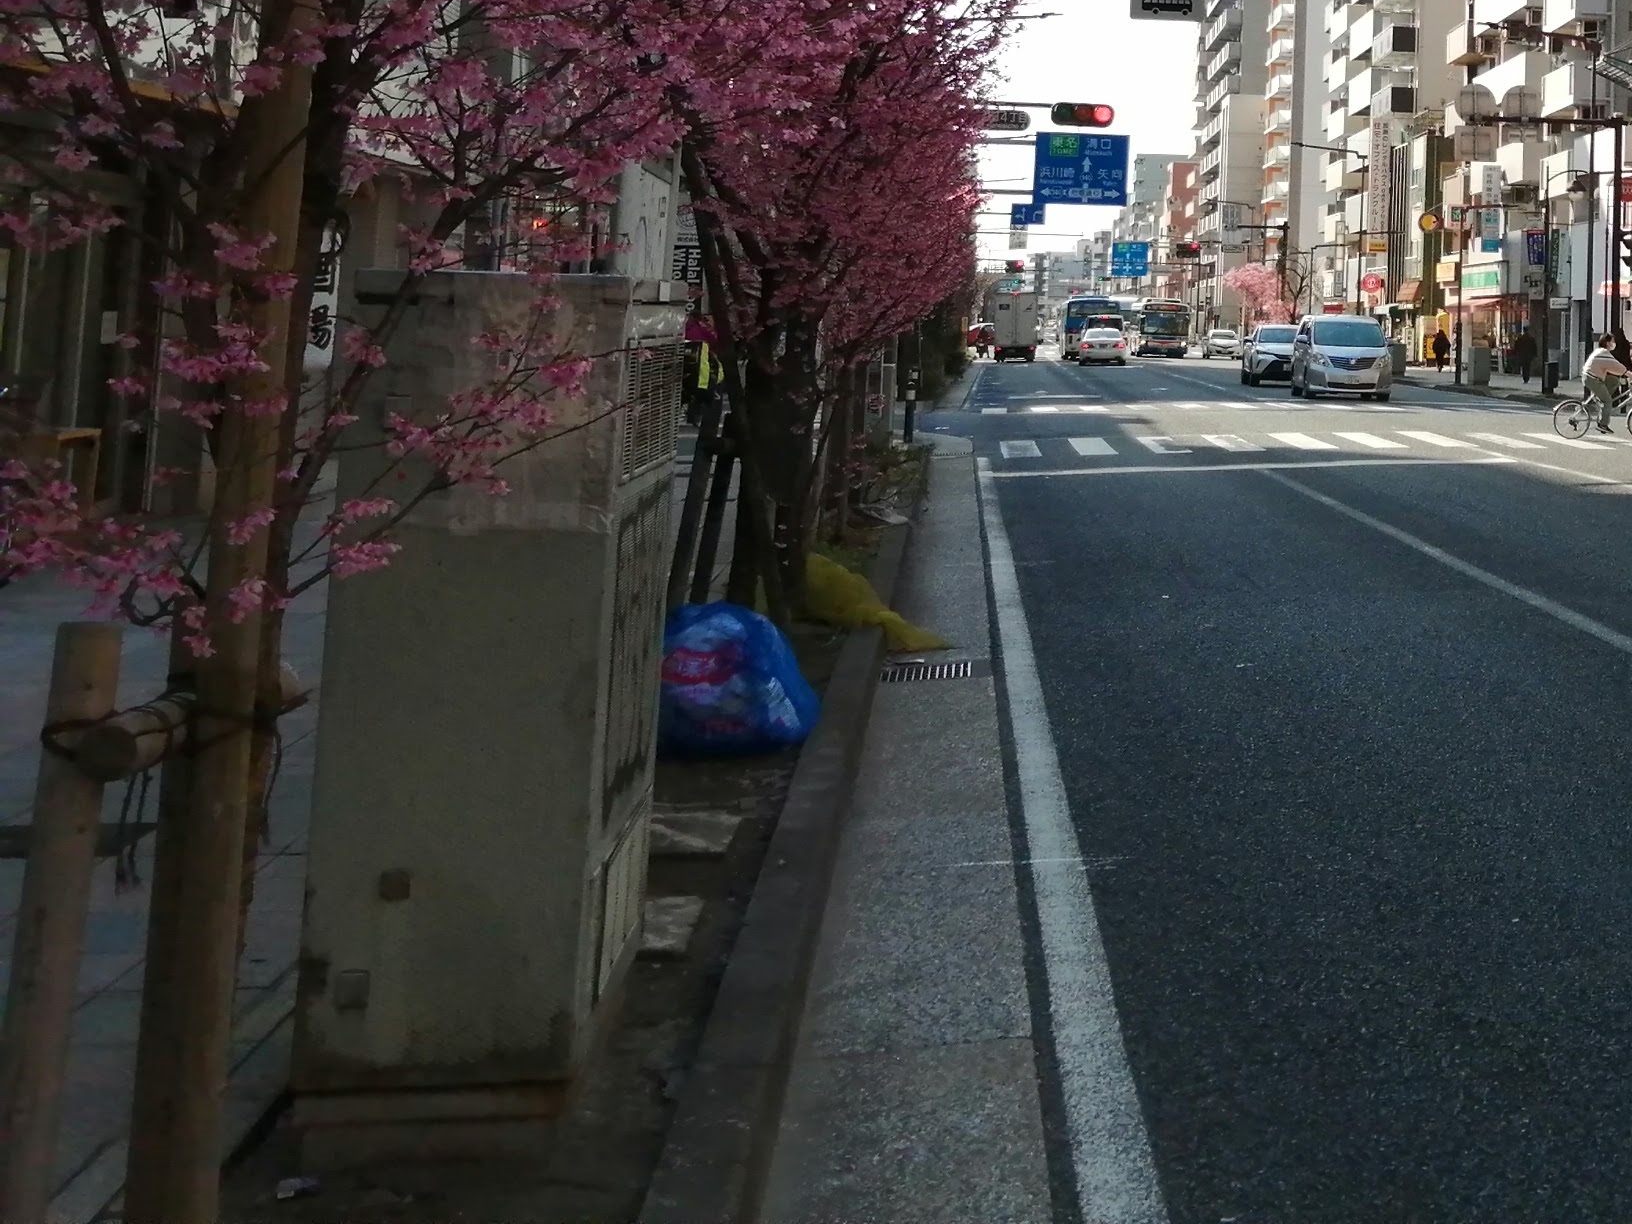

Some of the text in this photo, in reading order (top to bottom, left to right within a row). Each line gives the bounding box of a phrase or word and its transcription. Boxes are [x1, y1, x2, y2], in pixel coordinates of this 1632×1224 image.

[1039, 166, 1076, 178] 浜川崎
[687, 248, 702, 284] Halal
